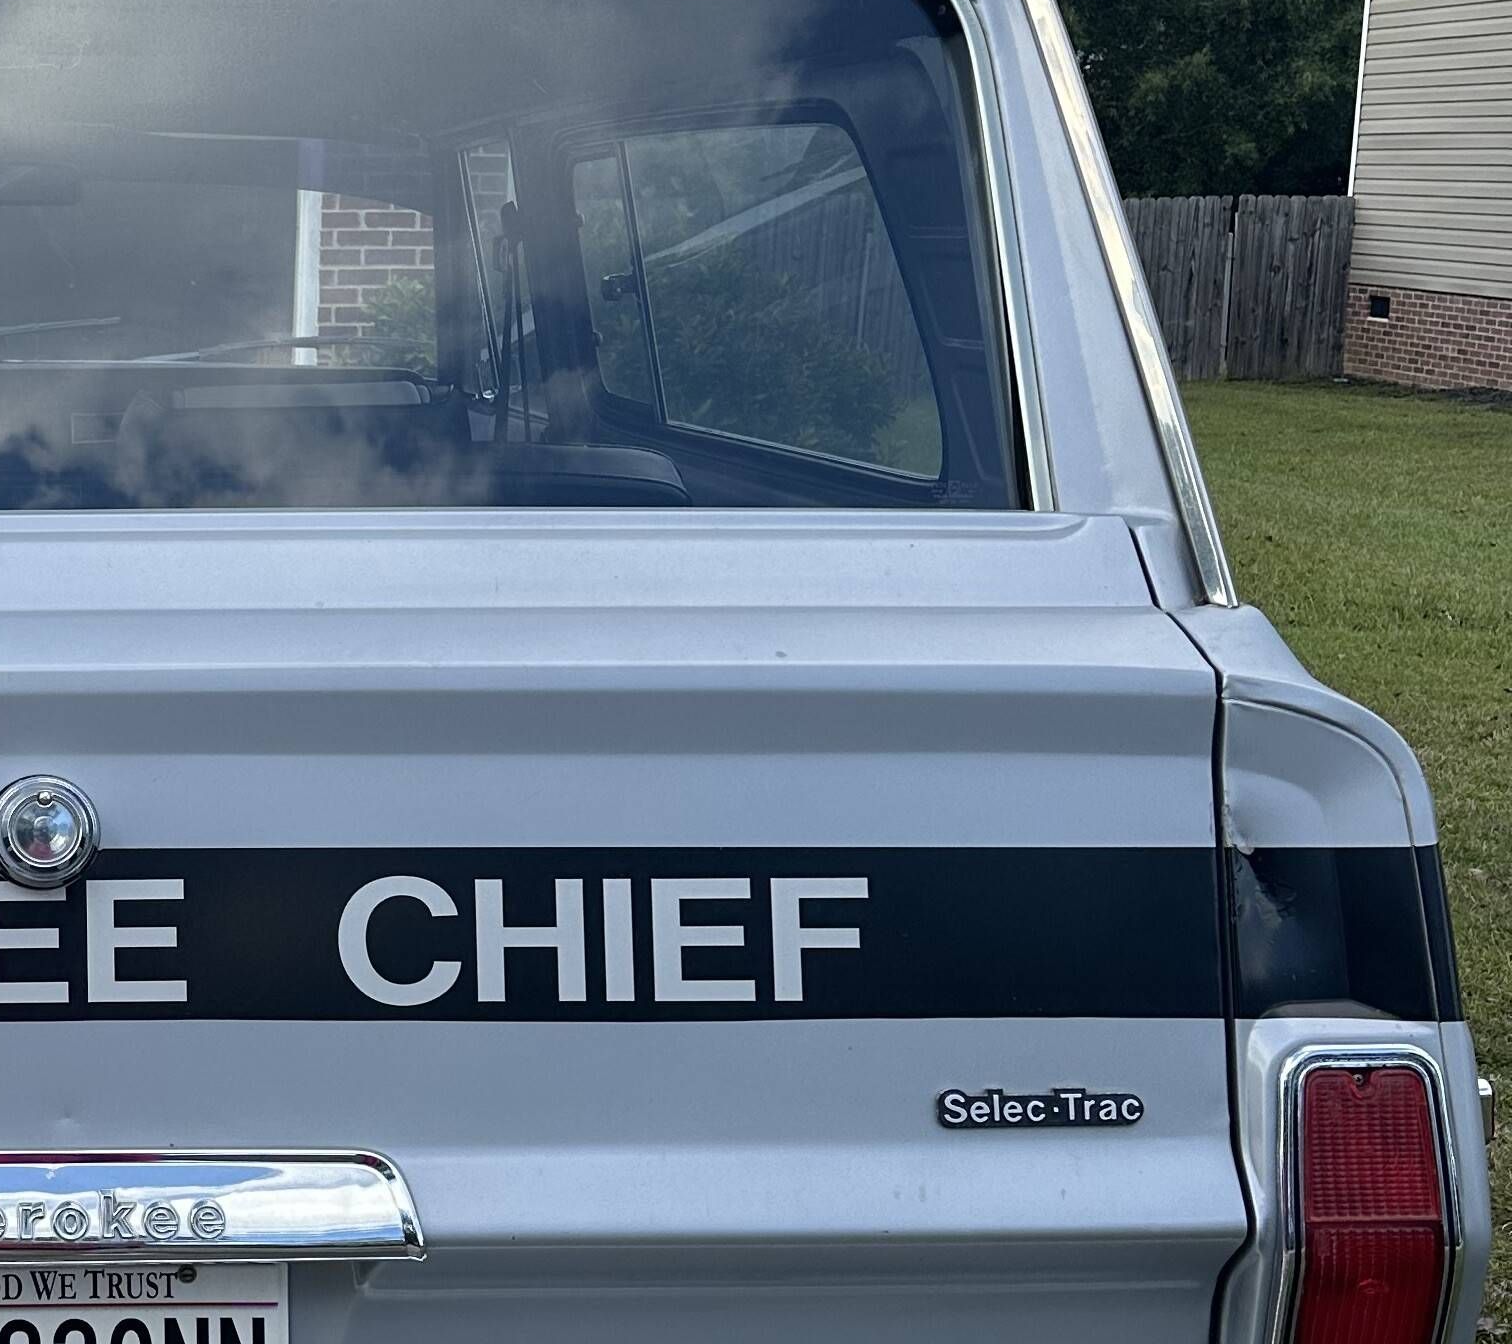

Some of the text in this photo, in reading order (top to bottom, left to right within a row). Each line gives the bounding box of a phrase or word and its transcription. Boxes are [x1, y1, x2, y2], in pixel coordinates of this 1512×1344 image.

[337, 875, 870, 1007] CHIEF
[30, 1270, 77, 1301] WE
[84, 1269, 178, 1300] TRUST
